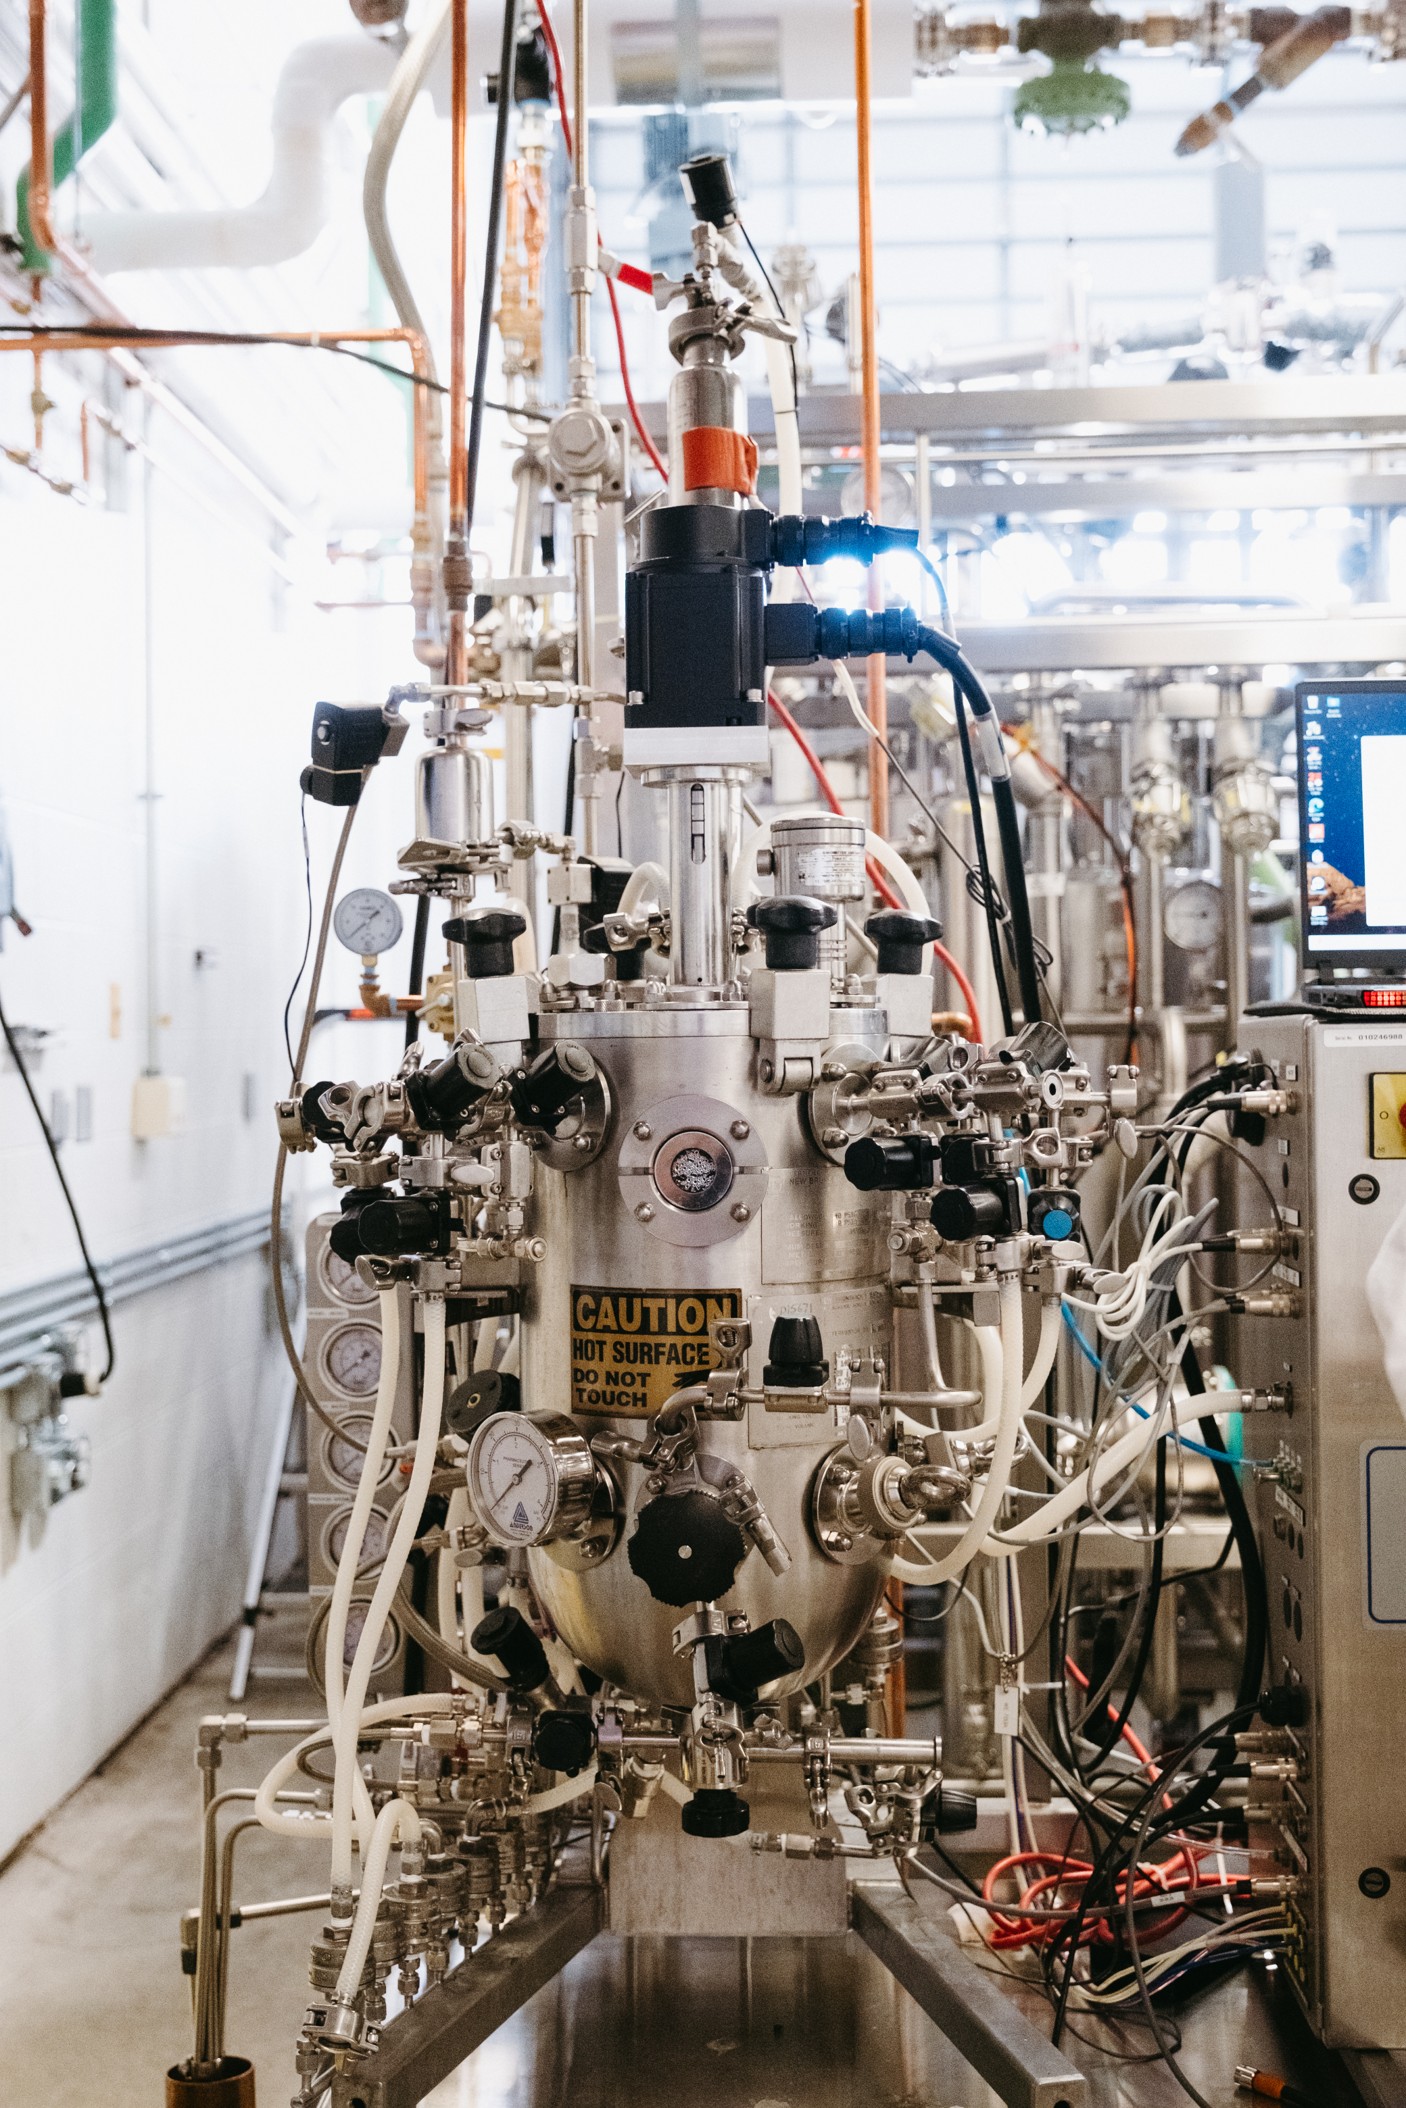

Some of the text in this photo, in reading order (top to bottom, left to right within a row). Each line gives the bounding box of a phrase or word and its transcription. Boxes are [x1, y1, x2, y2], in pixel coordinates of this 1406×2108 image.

[576, 1294, 732, 1334] CAUTION
[573, 1338, 710, 1366] HOT SURFACE
[573, 1368, 651, 1388] DO NOT
[576, 1388, 647, 1407] TOUCH
